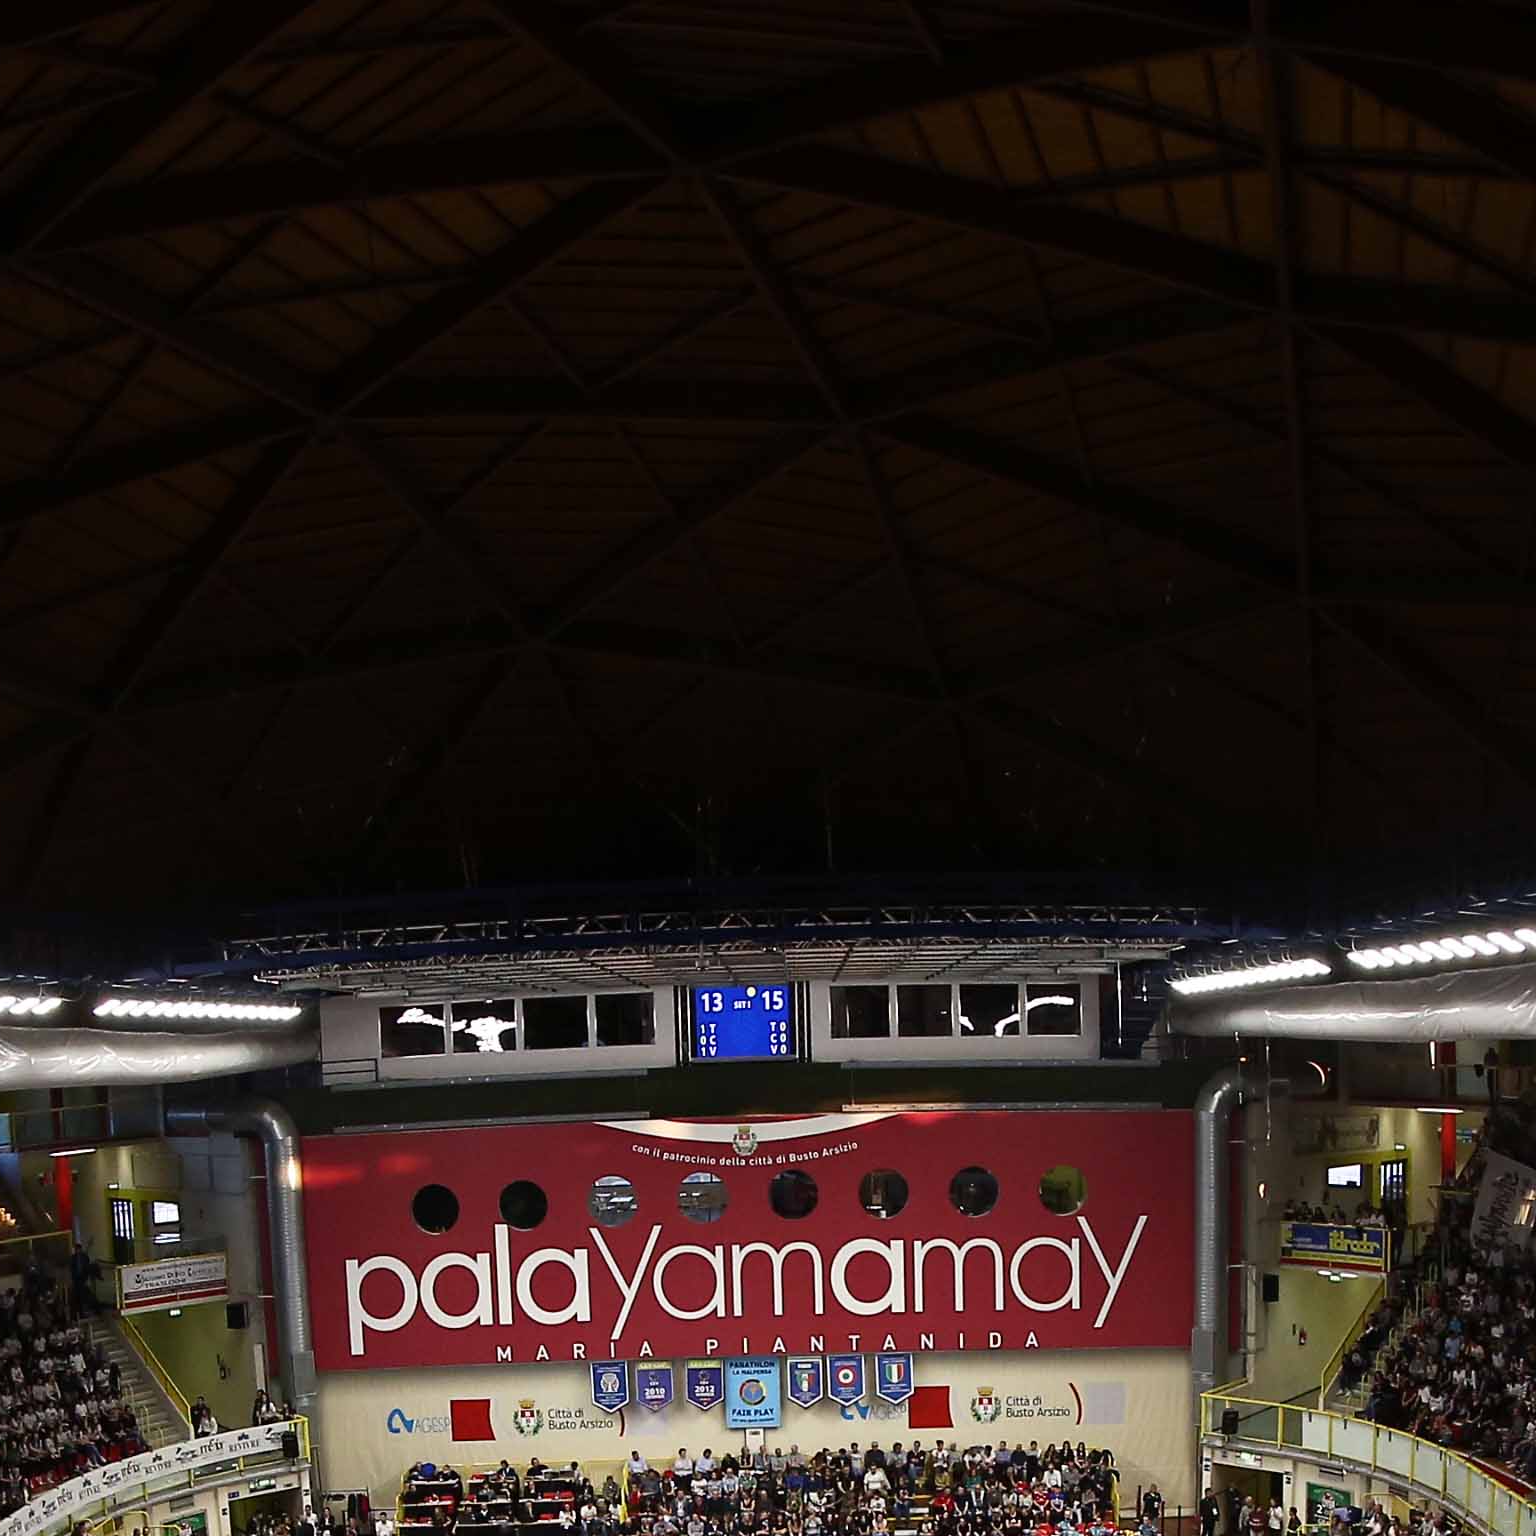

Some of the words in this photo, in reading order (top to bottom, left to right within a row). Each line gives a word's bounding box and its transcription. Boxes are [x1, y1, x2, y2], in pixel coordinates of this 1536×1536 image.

[701, 992, 723, 1012] 13
[761, 990, 784, 1010] 15
[709, 1024, 716, 1034] T
[770, 1022, 777, 1031] T
[779, 1022, 786, 1031] 0
[700, 1035, 707, 1045] 0
[709, 1035, 716, 1045] C
[770, 1033, 777, 1043] C
[780, 1033, 787, 1043] 0
[709, 1046, 717, 1056] V
[770, 1045, 778, 1054] V
[780, 1044, 787, 1054] 0
[632, 1144, 651, 1155] con
[652, 1146, 660, 1157] il
[663, 1152, 716, 1165] patrocinio
[719, 1156, 746, 1166] della
[749, 1153, 773, 1165] città
[776, 1153, 786, 1164] di
[789, 1150, 819, 1163] Busto
[822, 1141, 858, 1157] Arsizio
[346, 1215, 1149, 1355] palayamamay
[496, 1339, 653, 1363] MARIA
[707, 1331, 1040, 1355] PIANTANIDA
[694, 1385, 715, 1393] 2012
[1006, 1396, 1032, 1407] Città
[1035, 1395, 1042, 1406] di
[548, 1408, 573, 1419] Città
[575, 1408, 584, 1418] di
[754, 1408, 774, 1416] PLAY
[1006, 1407, 1033, 1418] Busto
[1037, 1406, 1071, 1417] Arsizio
[548, 1419, 576, 1430] Busto
[579, 1418, 613, 1429] Arsizio
